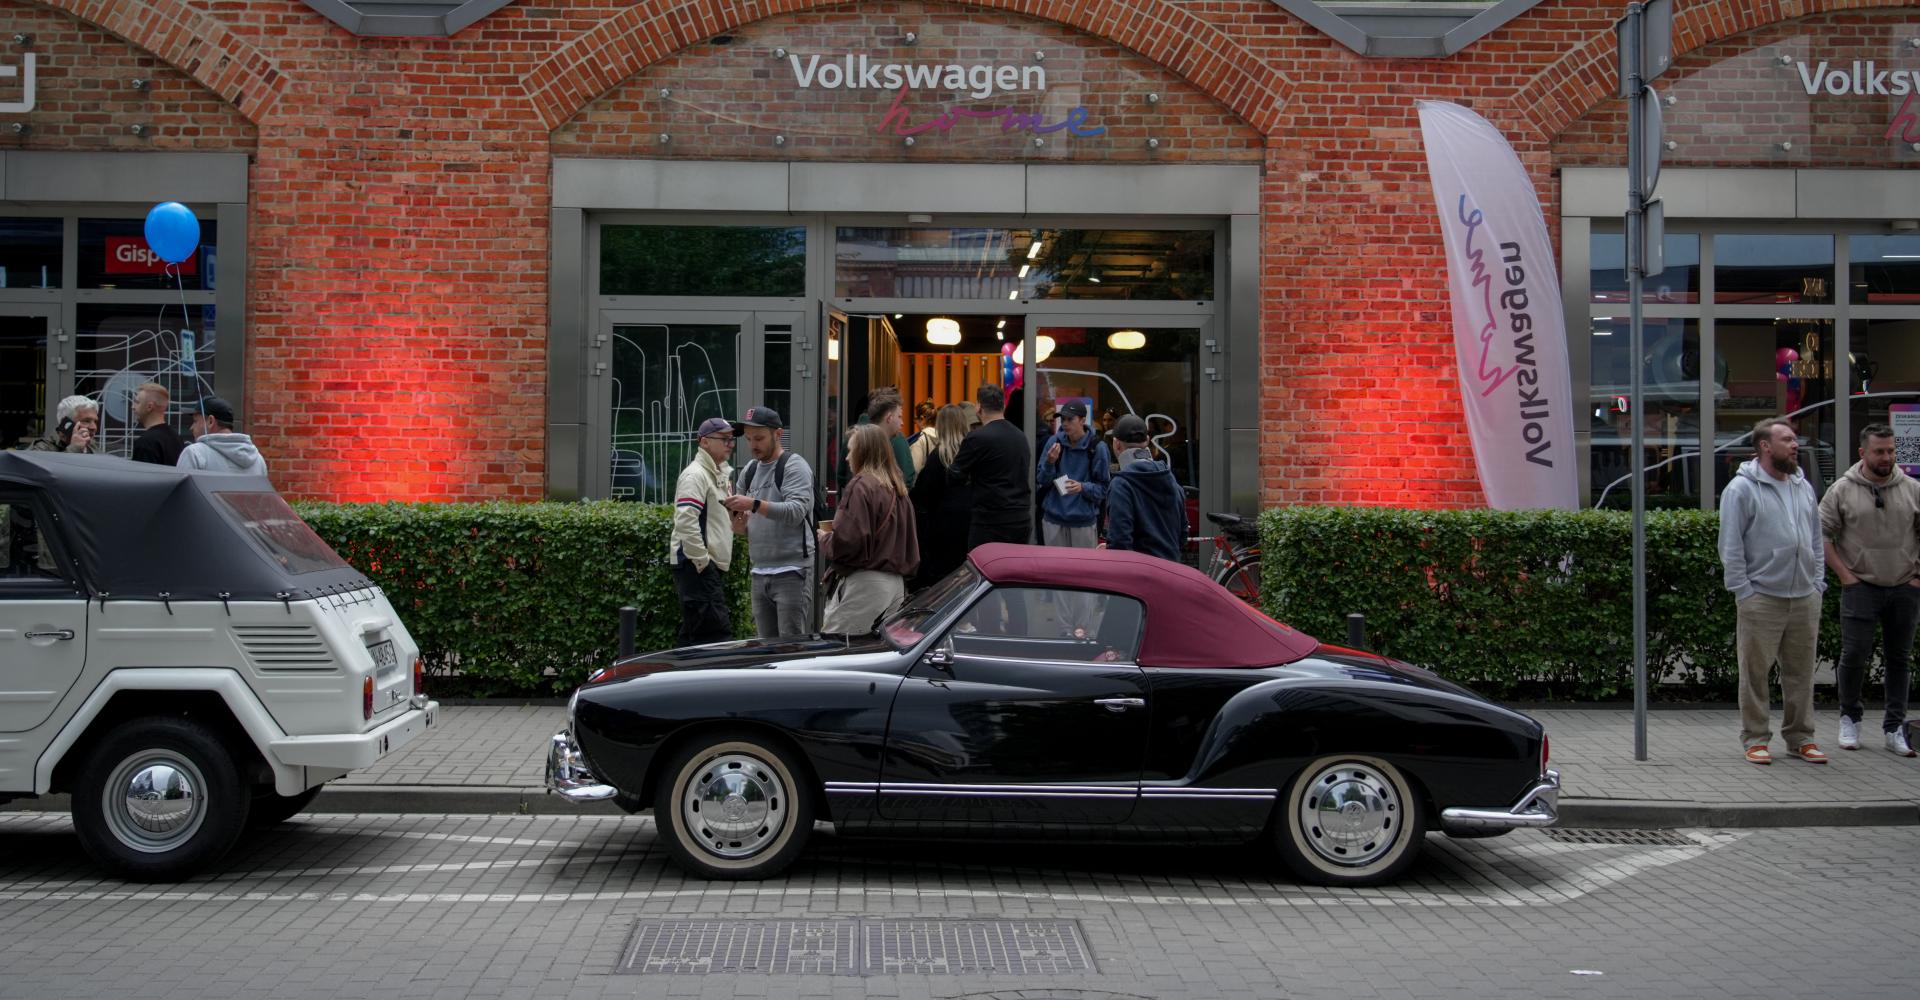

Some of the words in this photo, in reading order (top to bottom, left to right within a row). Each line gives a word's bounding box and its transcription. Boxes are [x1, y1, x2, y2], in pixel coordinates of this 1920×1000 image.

[789, 54, 1046, 99] Volkswagen
[1796, 60, 1920, 97] Volks
[875, 84, 1105, 135] home
[115, 243, 161, 267] Gisp
